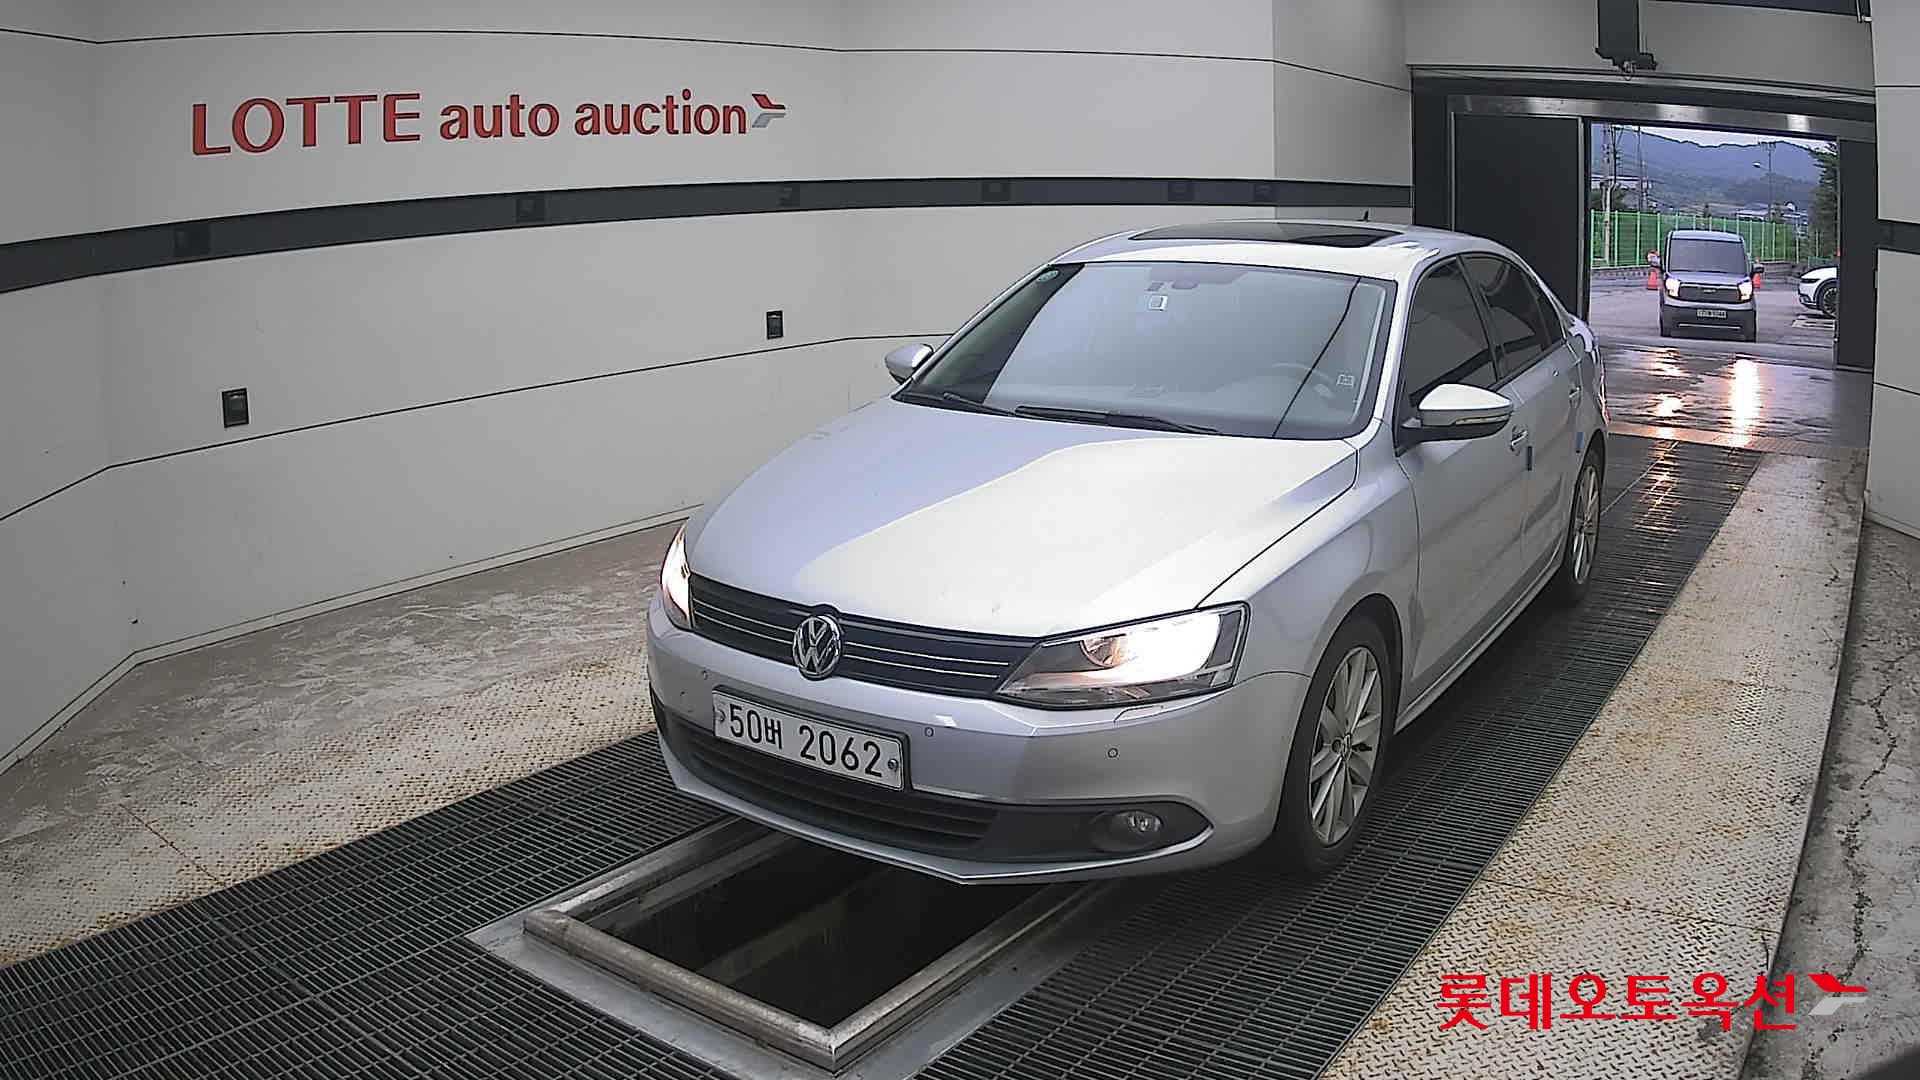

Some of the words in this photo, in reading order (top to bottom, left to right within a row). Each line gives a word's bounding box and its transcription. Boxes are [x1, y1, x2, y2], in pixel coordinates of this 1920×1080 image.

[192, 94, 420, 155] LOTTE
[439, 94, 560, 140] auto
[574, 88, 748, 136] auction
[729, 703, 783, 750] 50버
[798, 725, 883, 778] 2062
